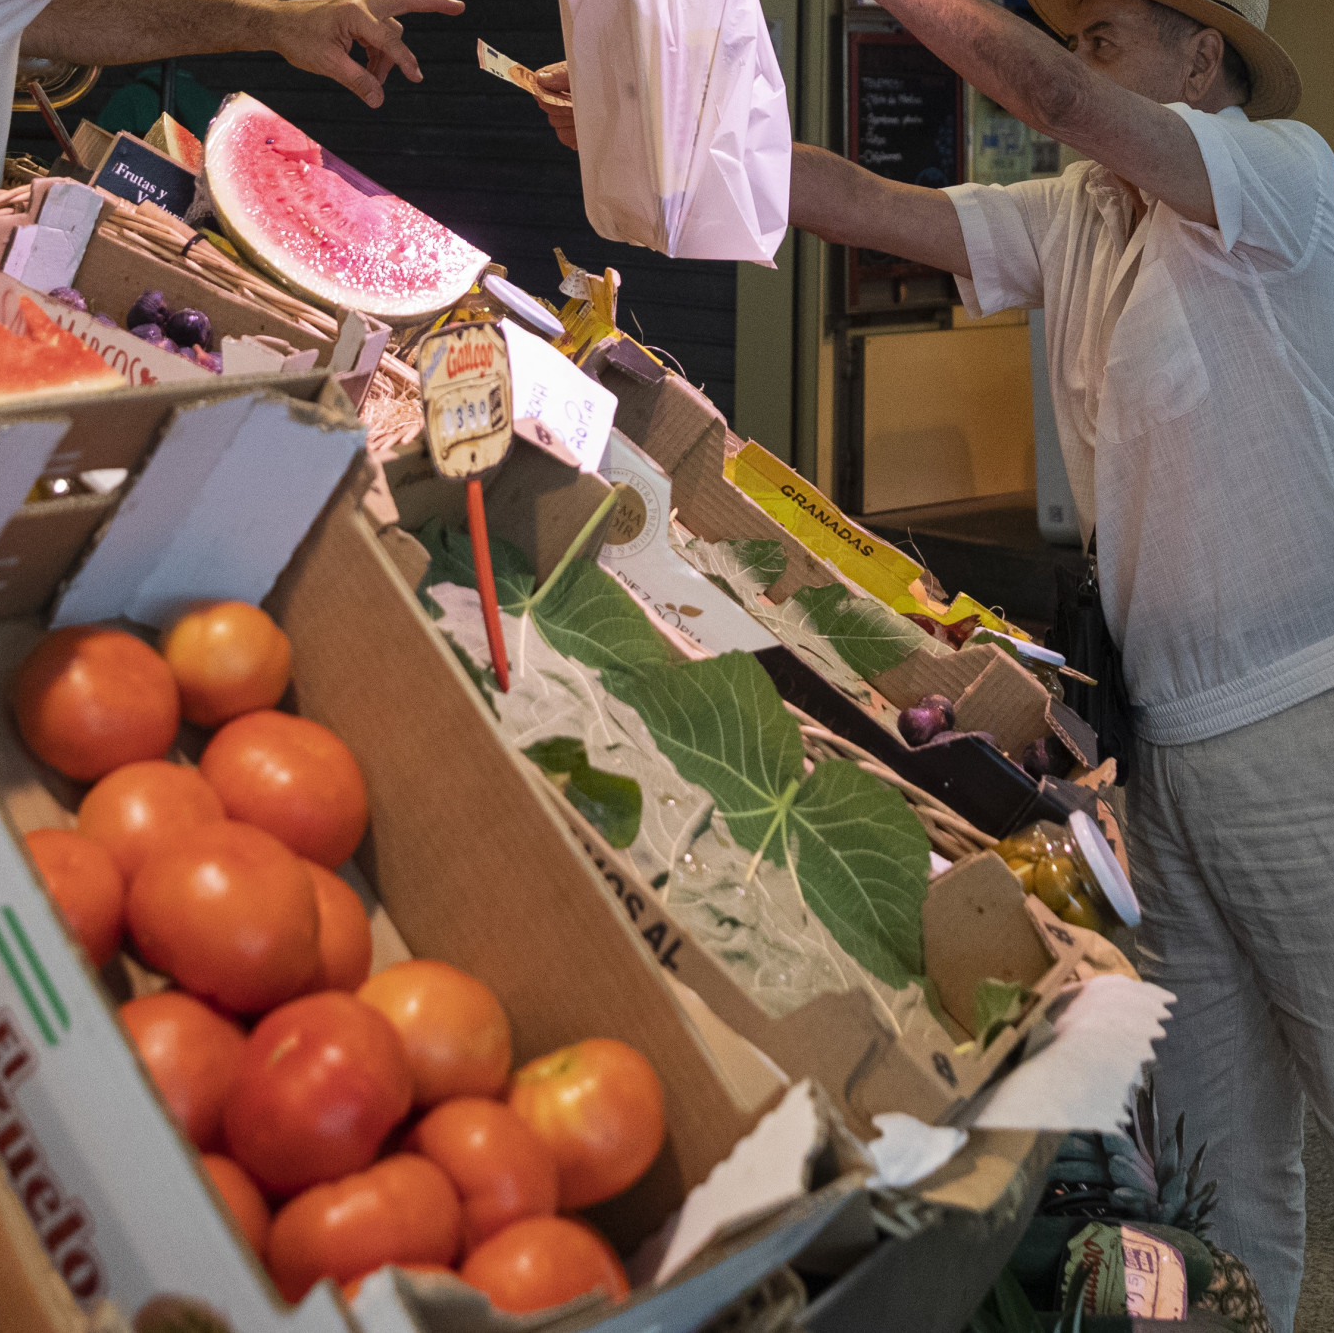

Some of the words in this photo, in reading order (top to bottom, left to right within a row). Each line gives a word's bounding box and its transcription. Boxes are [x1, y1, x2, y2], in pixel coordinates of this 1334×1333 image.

[517, 67, 536, 83] 10
[156, 189, 168, 200] y
[779, 483, 875, 558] GRANADAS
